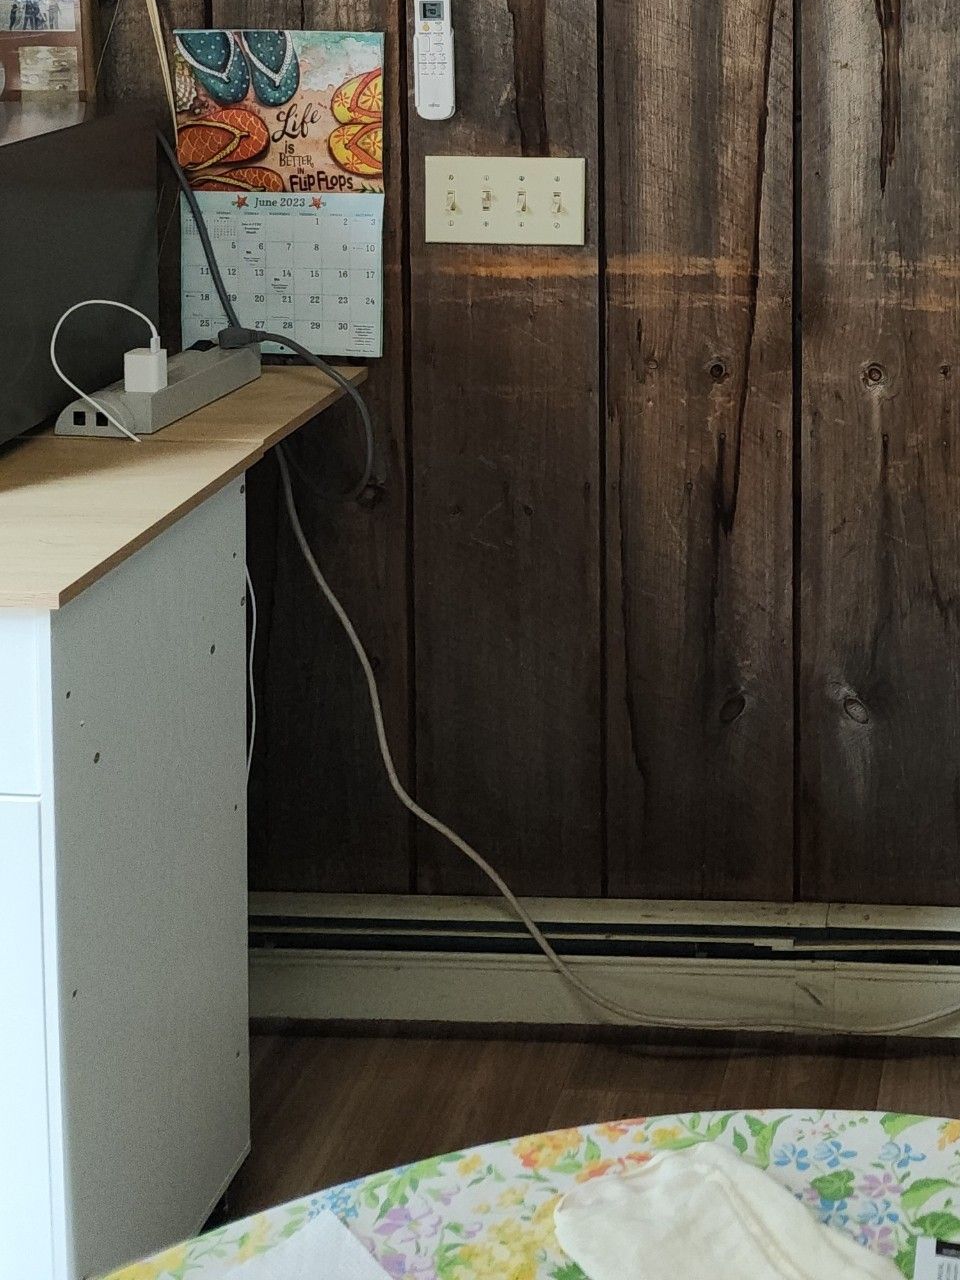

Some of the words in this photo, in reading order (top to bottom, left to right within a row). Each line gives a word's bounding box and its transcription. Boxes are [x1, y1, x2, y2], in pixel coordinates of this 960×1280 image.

[271, 103, 321, 142] Life
[284, 140, 295, 154] is
[279, 152, 314, 168] BETTER
[254, 198, 277, 208] June
[280, 198, 305, 207] 2023
[366, 243, 376, 252] 10
[200, 267, 210, 276] 11
[228, 268, 237, 276] 12
[255, 269, 265, 277] 13
[283, 270, 292, 278] 14
[311, 270, 320, 278] 15
[339, 271, 349, 279] 16
[367, 271, 375, 279] 17
[200, 294, 210, 302] 18
[227, 294, 237, 302] 19
[255, 295, 265, 303] 20
[282, 295, 292, 303] 21
[310, 296, 320, 304] 22
[338, 297, 348, 305] 23
[365, 297, 375, 305] 24
[200, 320, 210, 328] 25
[255, 321, 265, 329] 27
[283, 322, 293, 330] 28
[311, 322, 321, 330] 29
[339, 323, 349, 331] 30
